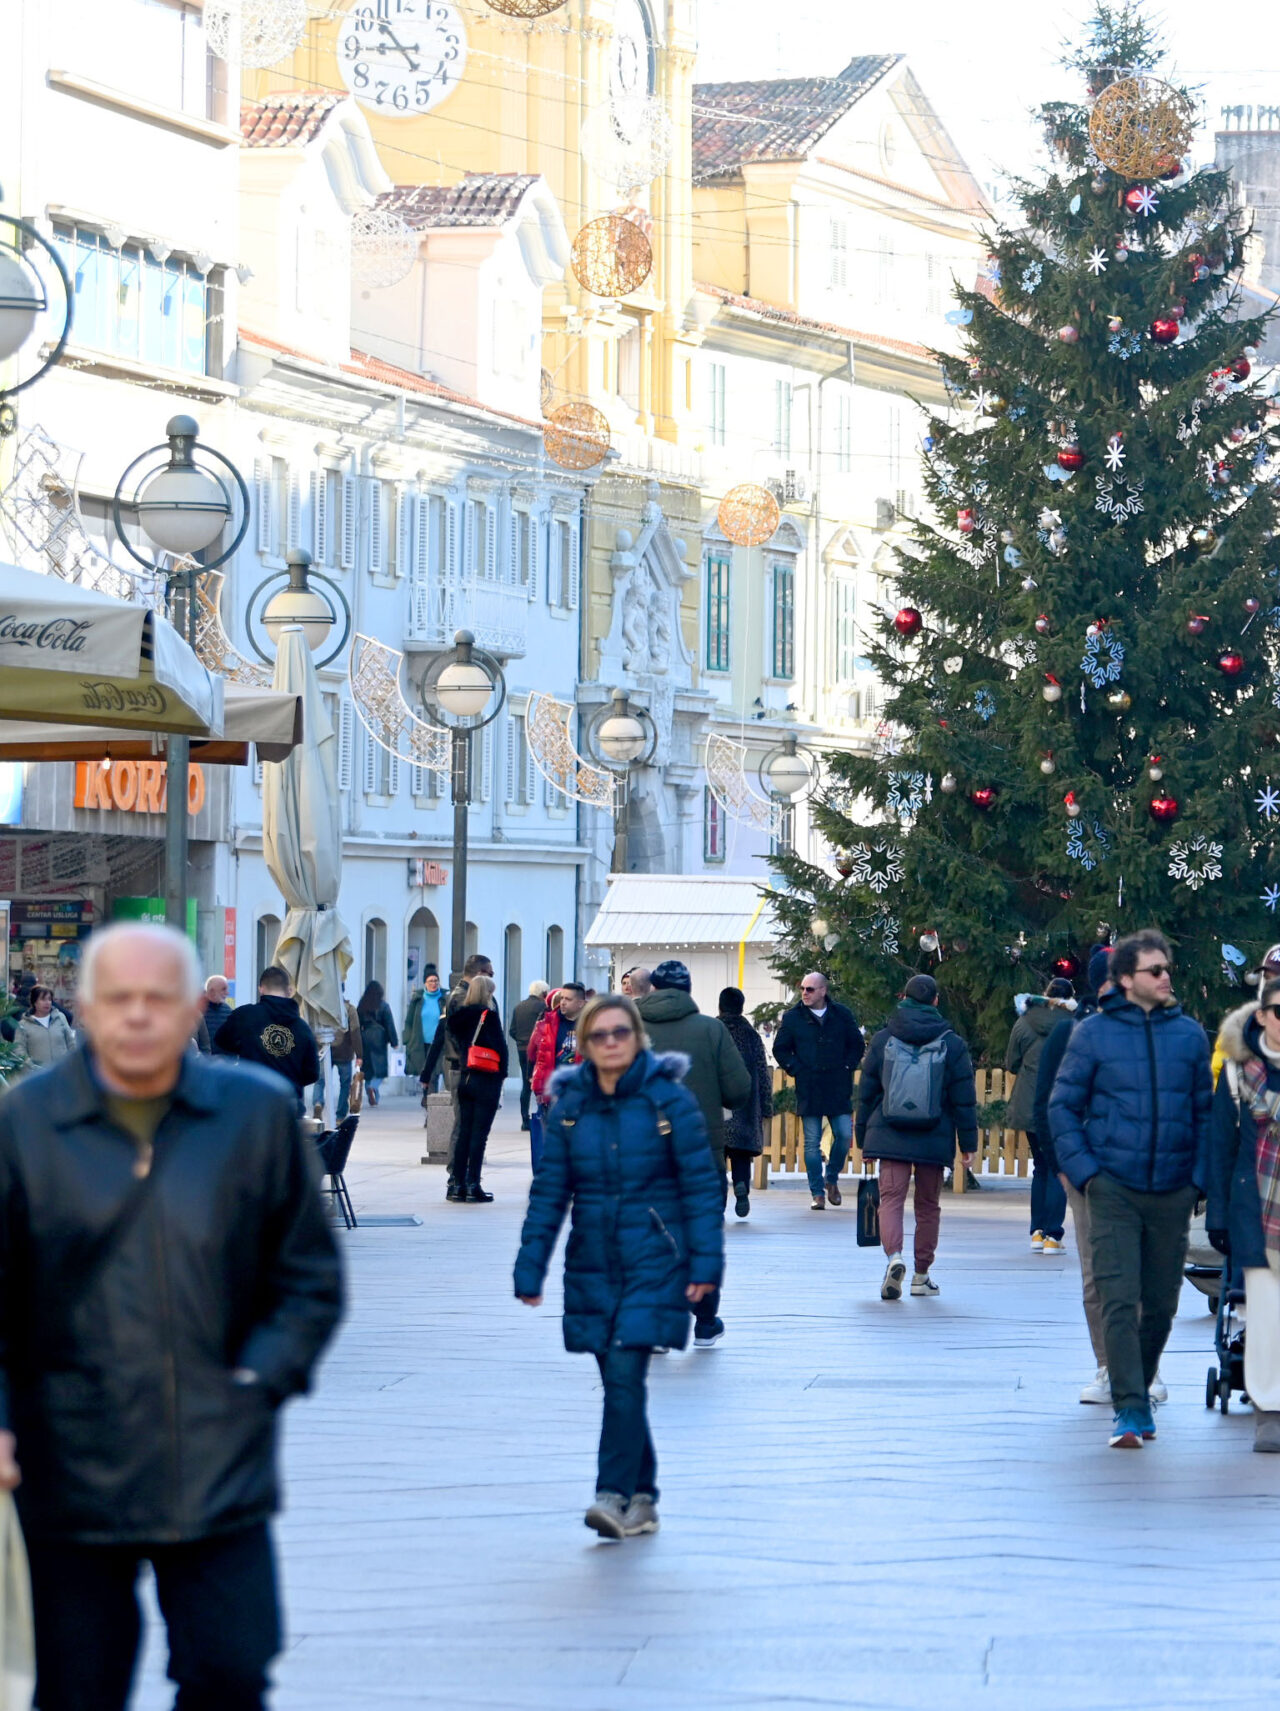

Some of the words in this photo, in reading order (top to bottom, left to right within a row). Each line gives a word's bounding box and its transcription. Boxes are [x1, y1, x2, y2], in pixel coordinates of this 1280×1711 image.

[354, 7, 375, 32] 10
[436, 8, 449, 33] 2
[344, 35, 361, 60] 9
[444, 34, 460, 61] 3
[353, 62, 370, 88] 8
[432, 60, 450, 85] 4
[375, 80, 390, 105] 7
[392, 84, 409, 110] 6
[415, 79, 431, 105] 5
[74, 761, 206, 816] KORO
[26, 911, 52, 919] CENTAR
